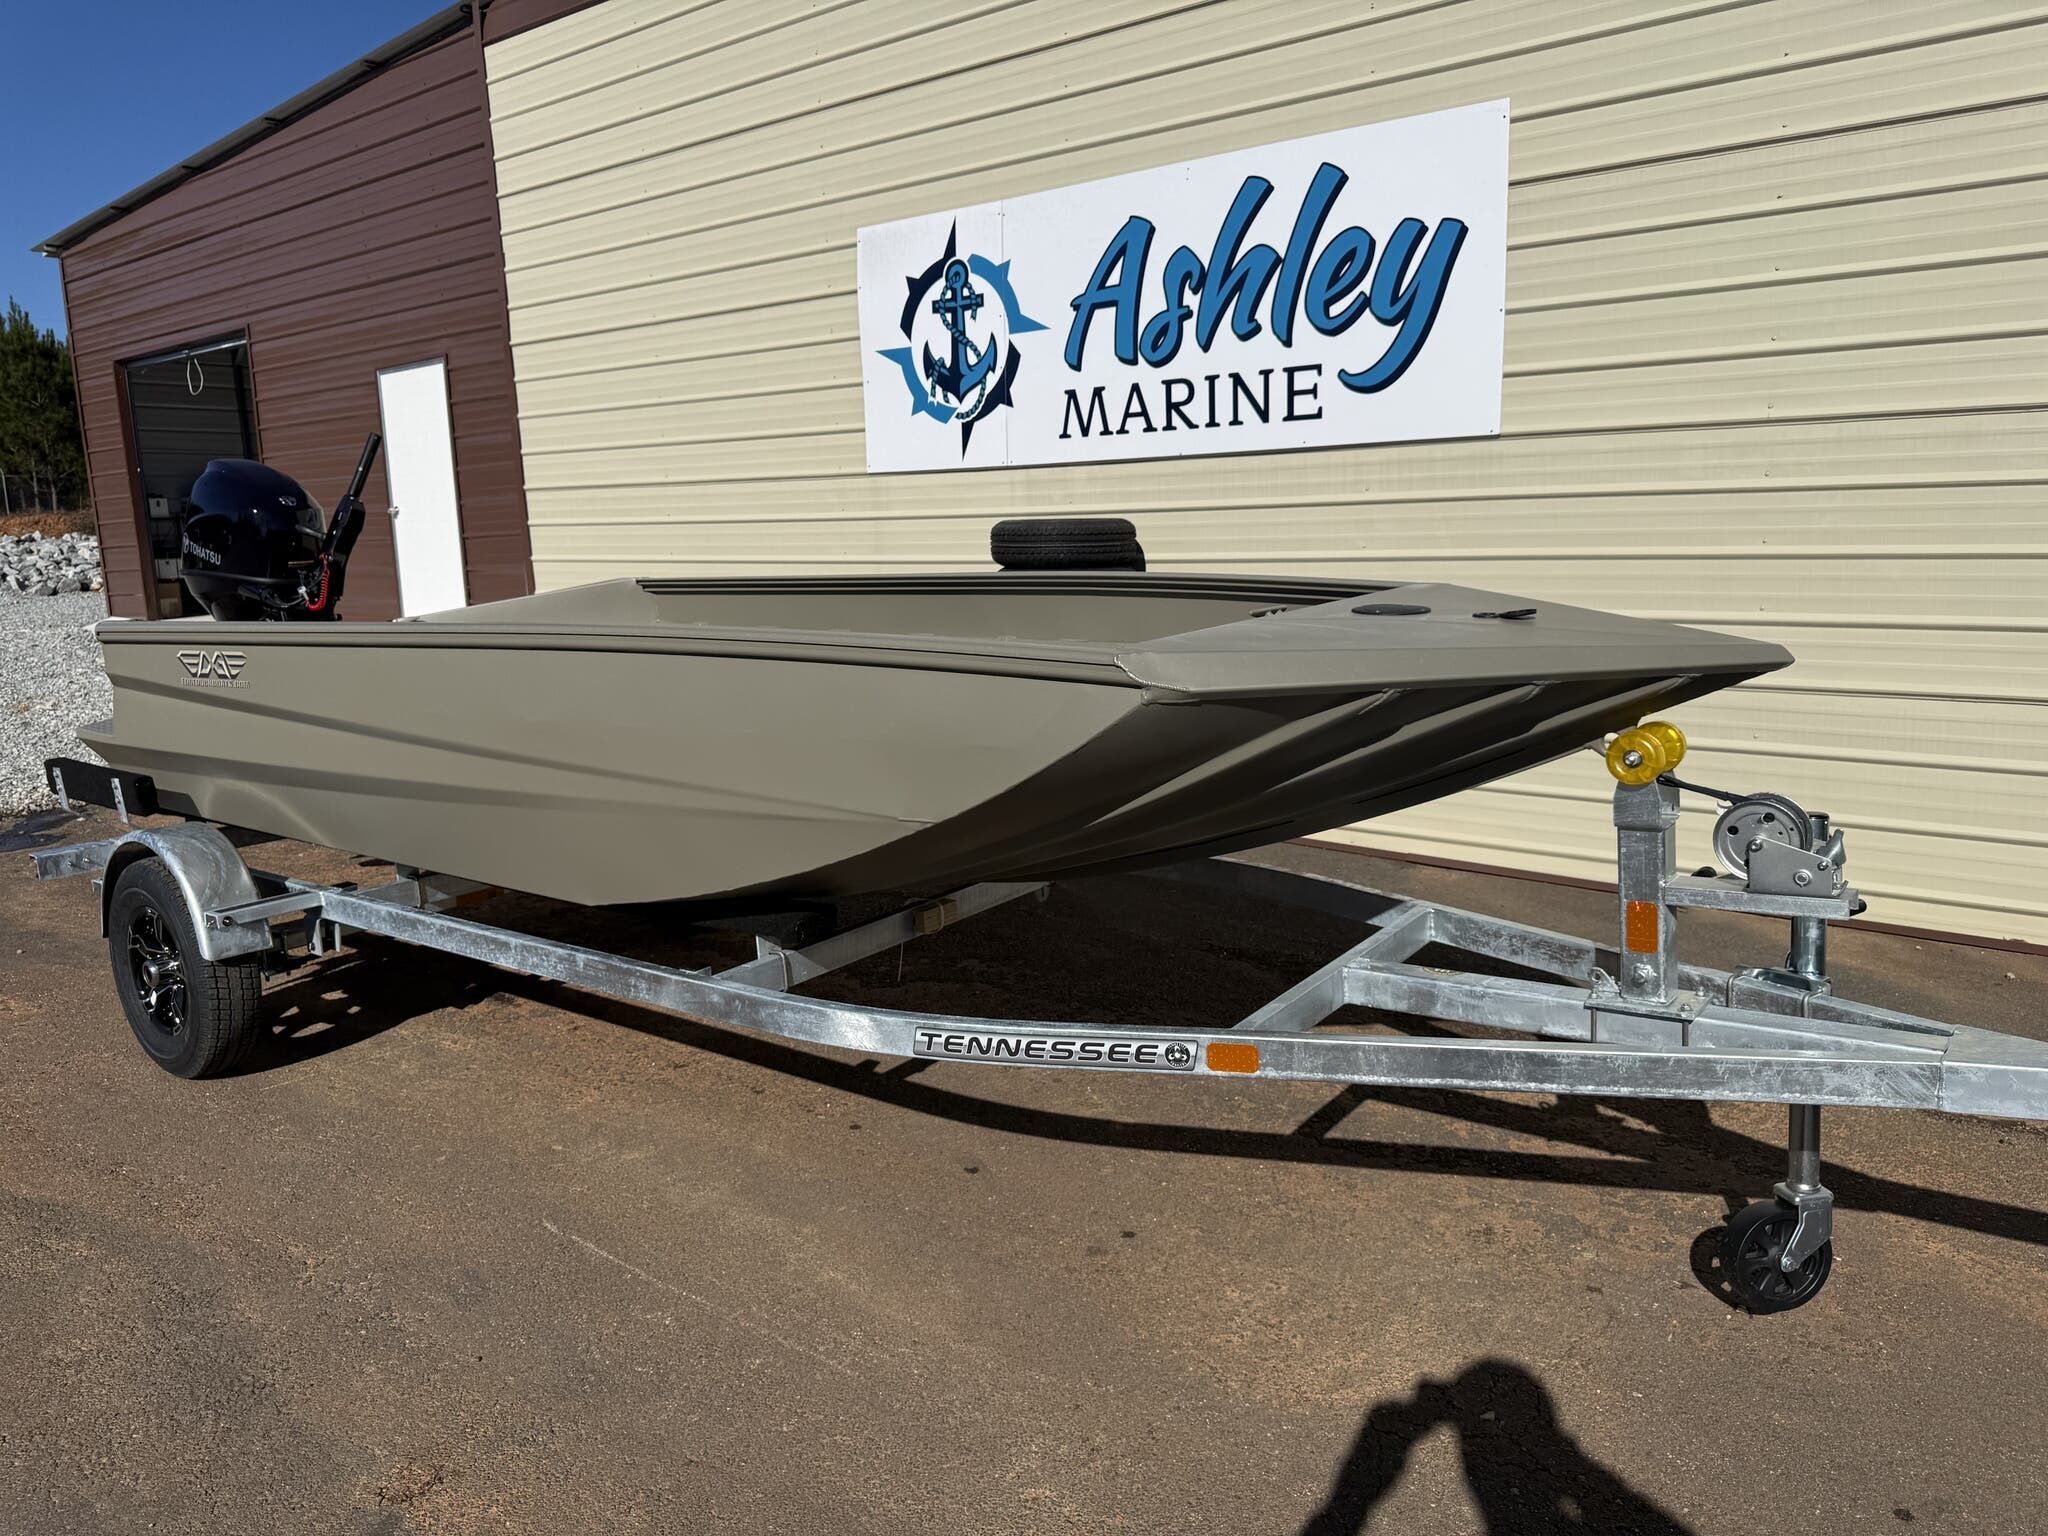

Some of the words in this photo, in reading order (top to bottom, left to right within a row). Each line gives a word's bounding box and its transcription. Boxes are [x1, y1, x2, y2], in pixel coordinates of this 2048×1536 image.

[1064, 162, 1468, 393] Ashley
[1060, 364, 1323, 439] MARINE
[190, 541, 222, 565] TOHATSU
[176, 650, 247, 679] EDGE
[920, 1032, 1159, 1064] TENNESSEE
